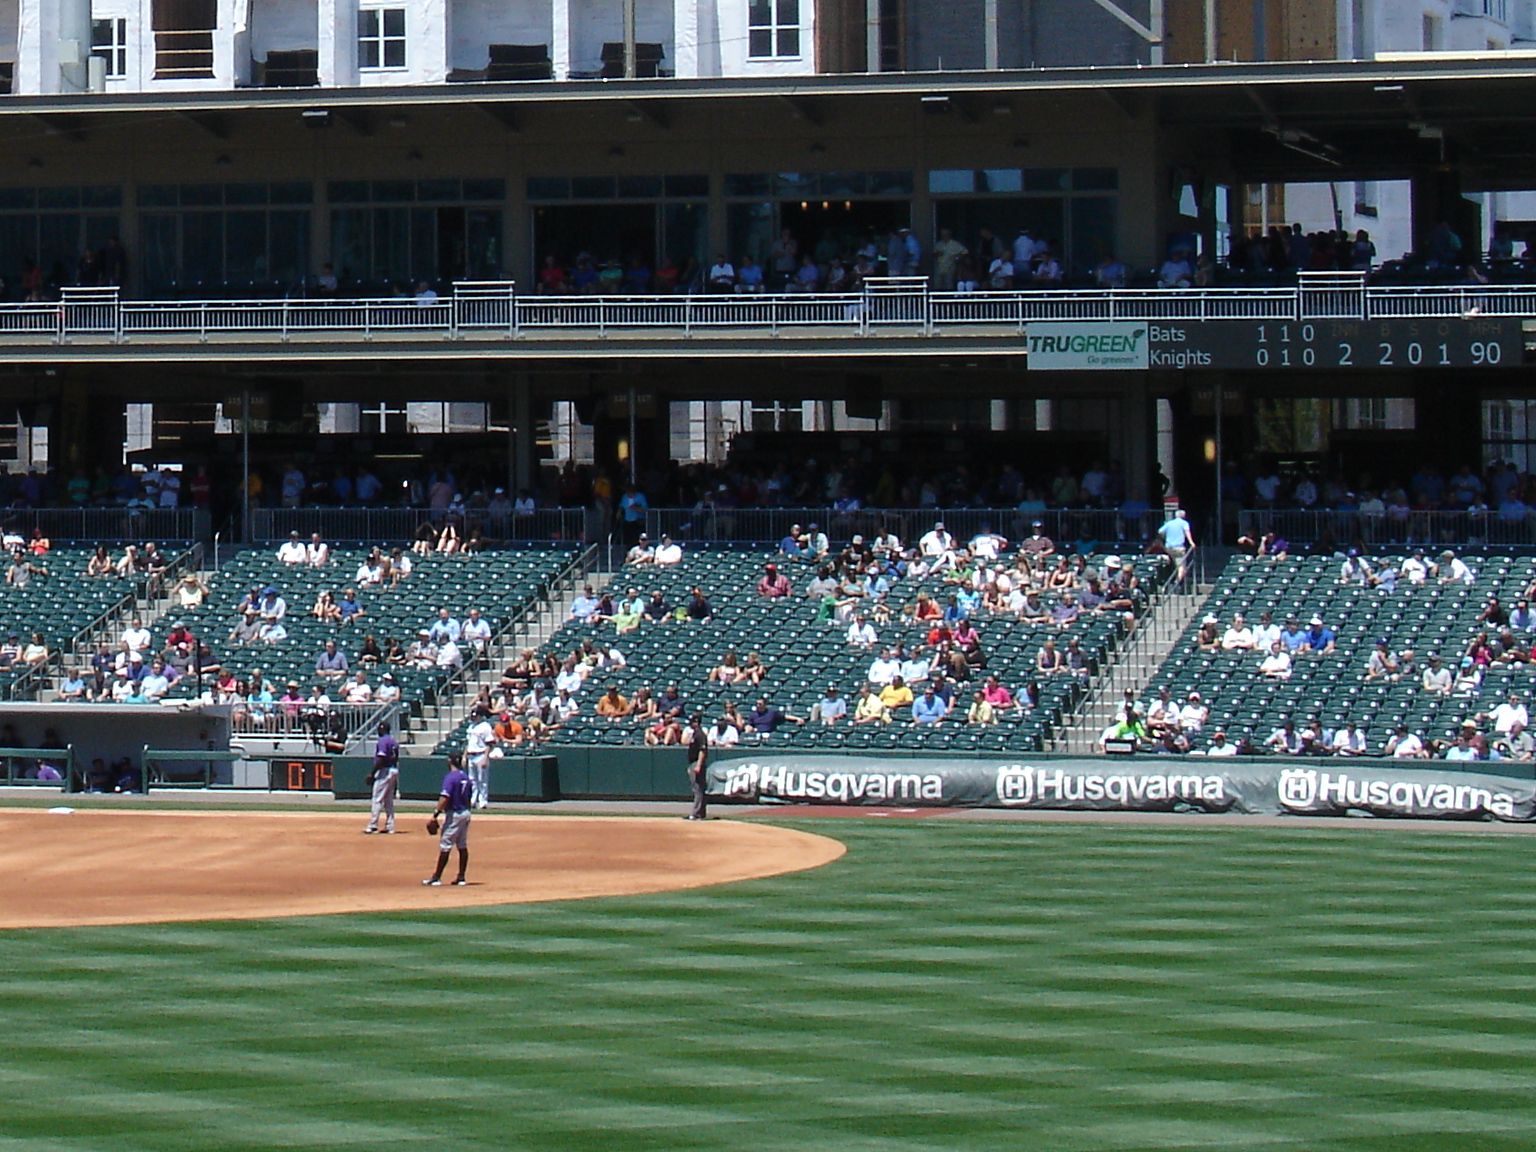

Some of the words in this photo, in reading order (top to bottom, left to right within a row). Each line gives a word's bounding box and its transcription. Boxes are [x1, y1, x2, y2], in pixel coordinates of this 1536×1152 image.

[1029, 335, 1137, 353] TRUGREEN
[1149, 326, 1186, 342] Bats
[1257, 326, 1267, 342] 1
[1280, 326, 1290, 342] 1
[1302, 325, 1314, 342] 0
[1150, 350, 1212, 369] Knights
[1256, 349, 1268, 366] 0
[1281, 349, 1291, 366] 1
[1303, 349, 1315, 366] 0
[1338, 343, 1353, 365] 2
[1378, 343, 1393, 365] 2
[1407, 343, 1422, 365] 0
[1438, 343, 1451, 365] 1
[1470, 342, 1501, 365] 90
[760, 766, 943, 802] Husqvarna
[1036, 769, 1224, 805] Husqvarna
[1319, 773, 1514, 816] Husqvarna
